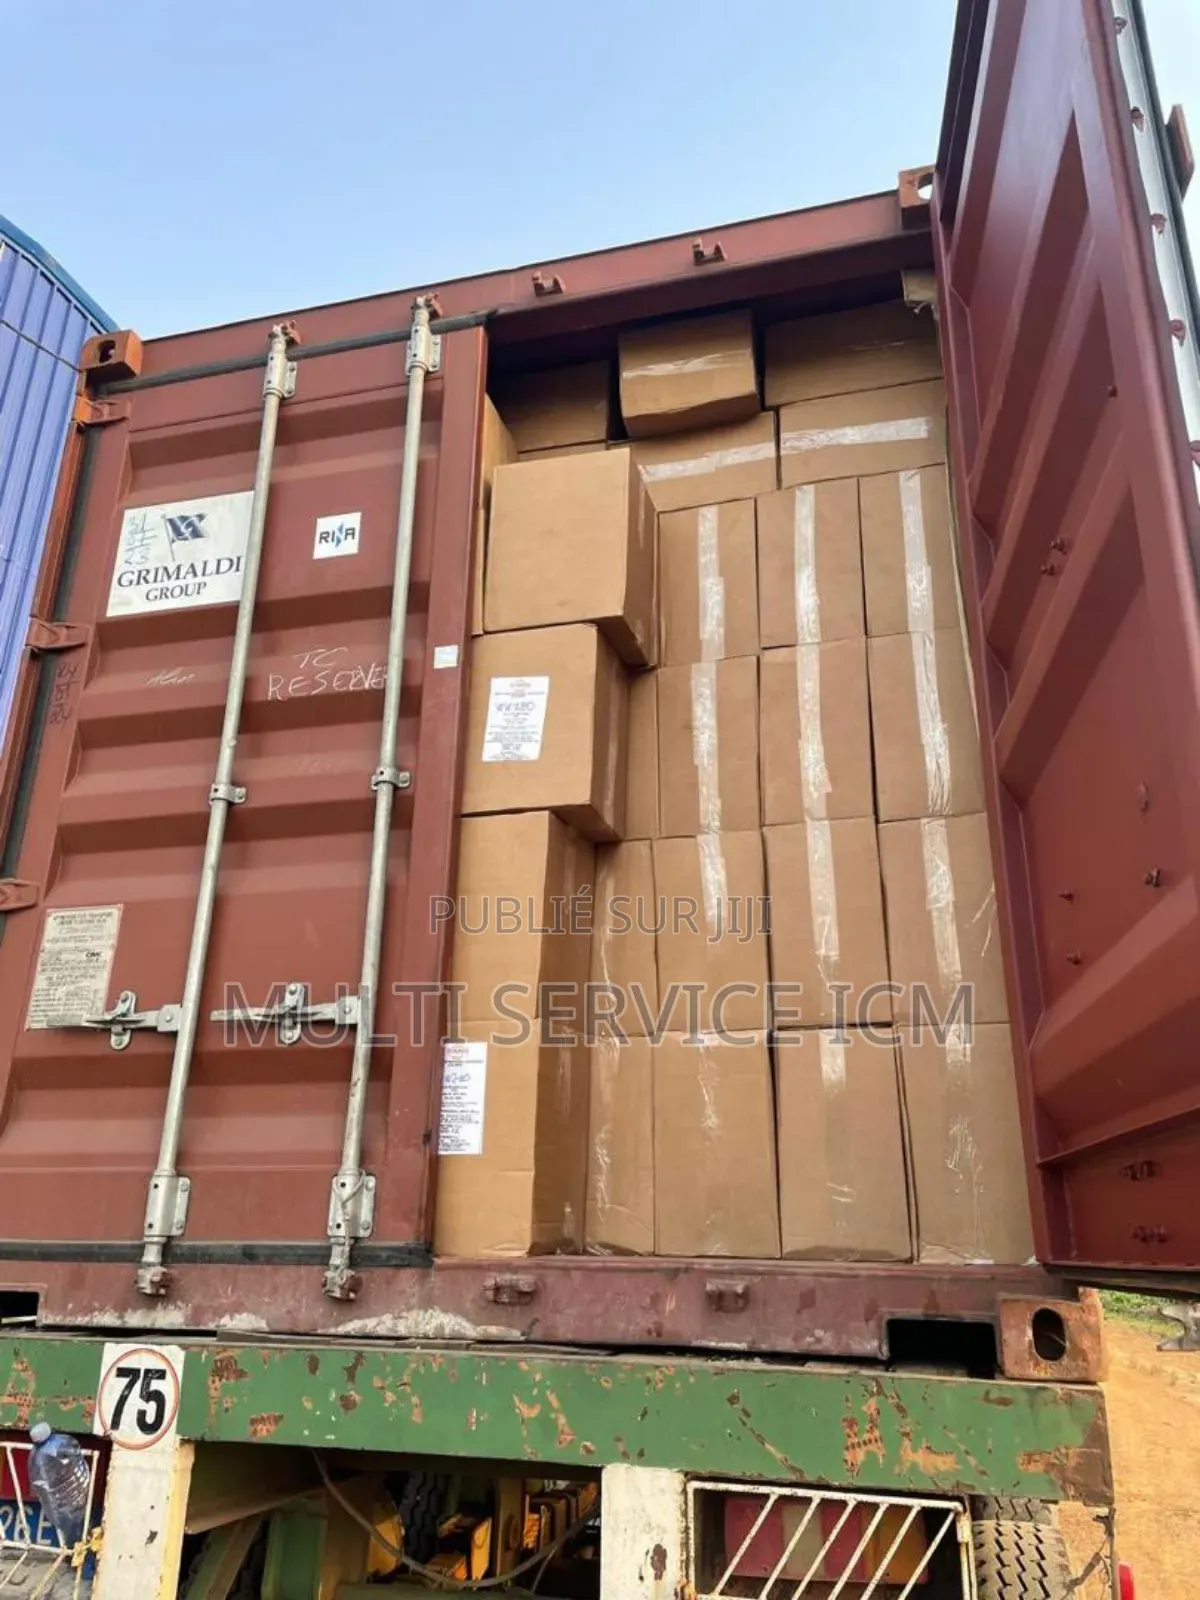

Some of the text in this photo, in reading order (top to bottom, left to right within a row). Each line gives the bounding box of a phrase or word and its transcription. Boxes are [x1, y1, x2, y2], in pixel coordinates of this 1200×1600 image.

[117, 555, 243, 588] GRIMALDI
[145, 582, 207, 601] GROUP
[110, 1366, 167, 1436] 75
